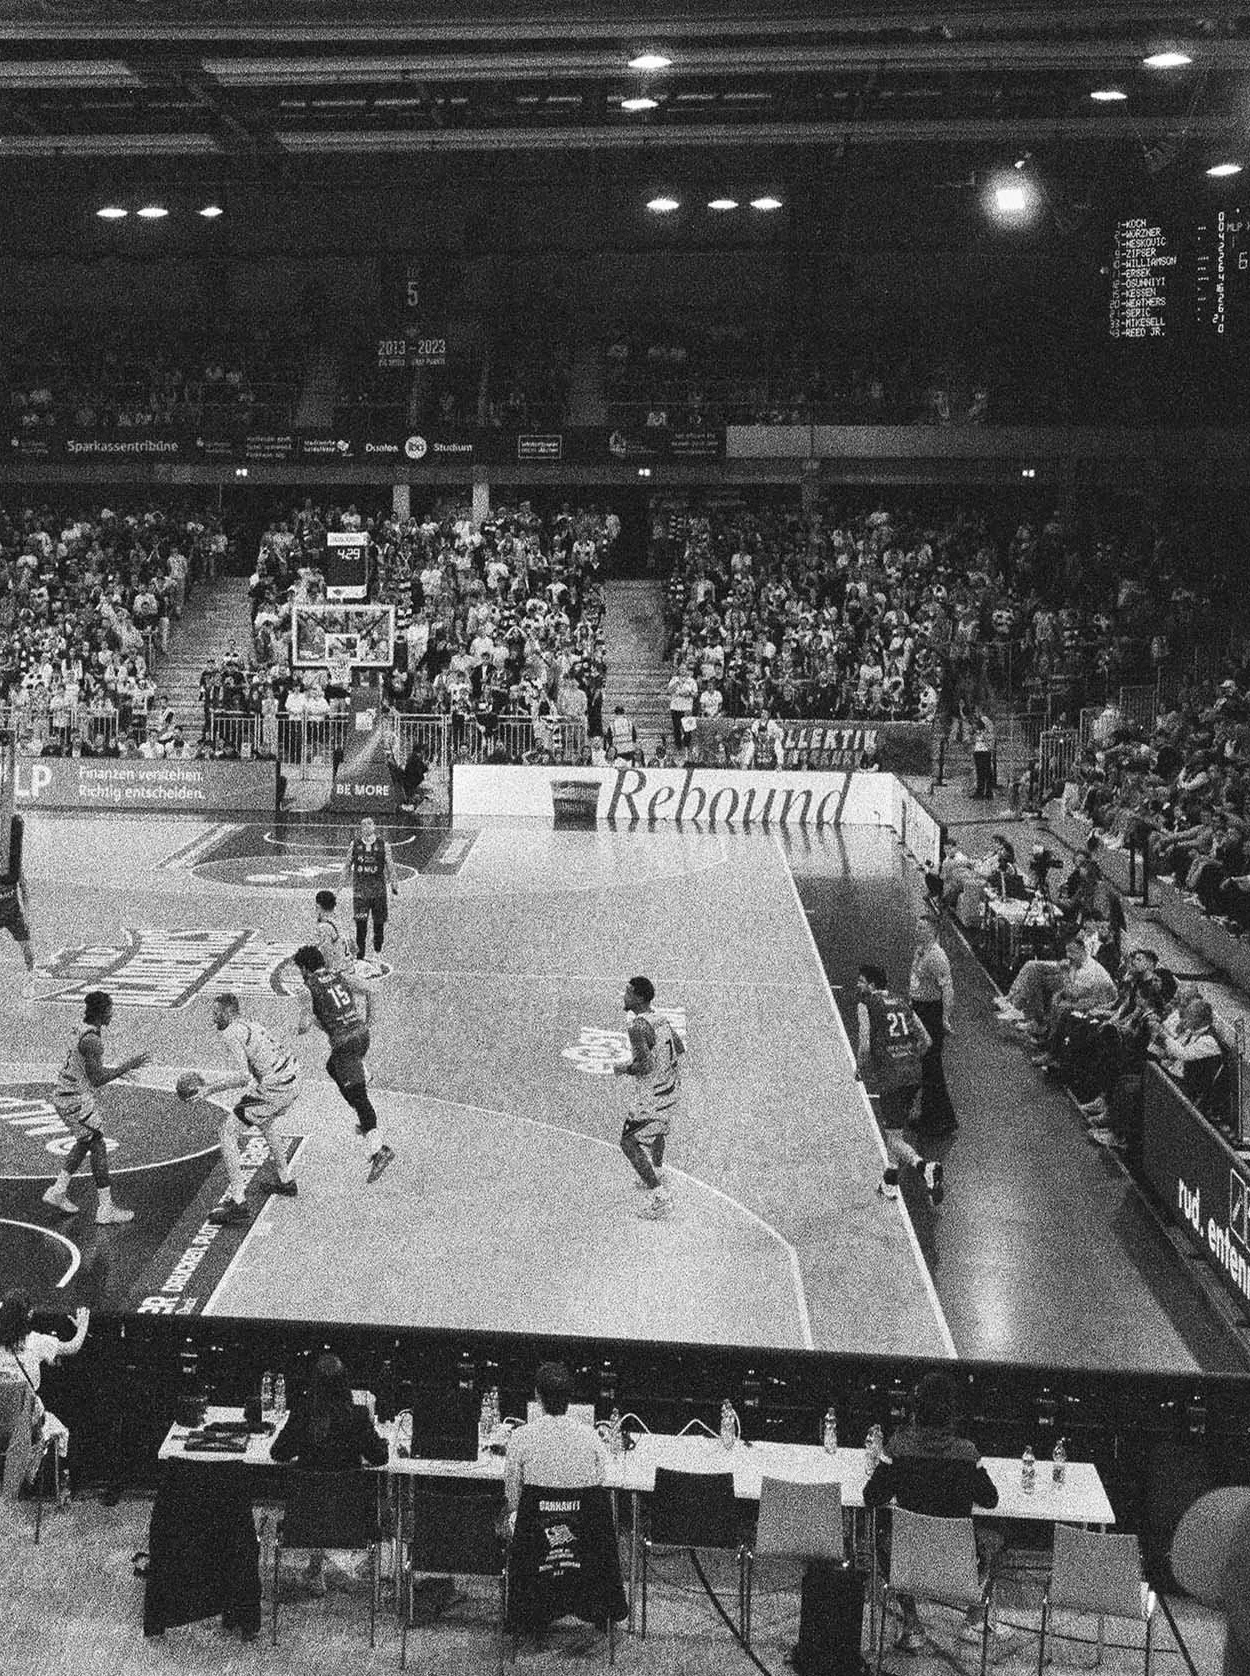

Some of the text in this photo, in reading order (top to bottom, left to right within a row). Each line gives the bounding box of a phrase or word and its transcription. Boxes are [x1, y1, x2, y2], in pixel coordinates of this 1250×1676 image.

[406, 281, 419, 306] 5
[378, 340, 406, 356] 2013
[418, 339, 446, 355] 2023
[66, 439, 179, 452] Sparkassentribüne
[365, 442, 399, 453] Duales
[432, 442, 473, 453] Studium
[78, 766, 204, 782] Finanzen verstehen.
[78, 784, 207, 802] Richtig entscheiden.
[336, 783, 390, 797] BE MORE
[607, 767, 852, 825] Rebound
[327, 985, 351, 1009] 15
[886, 1012, 909, 1037] 21
